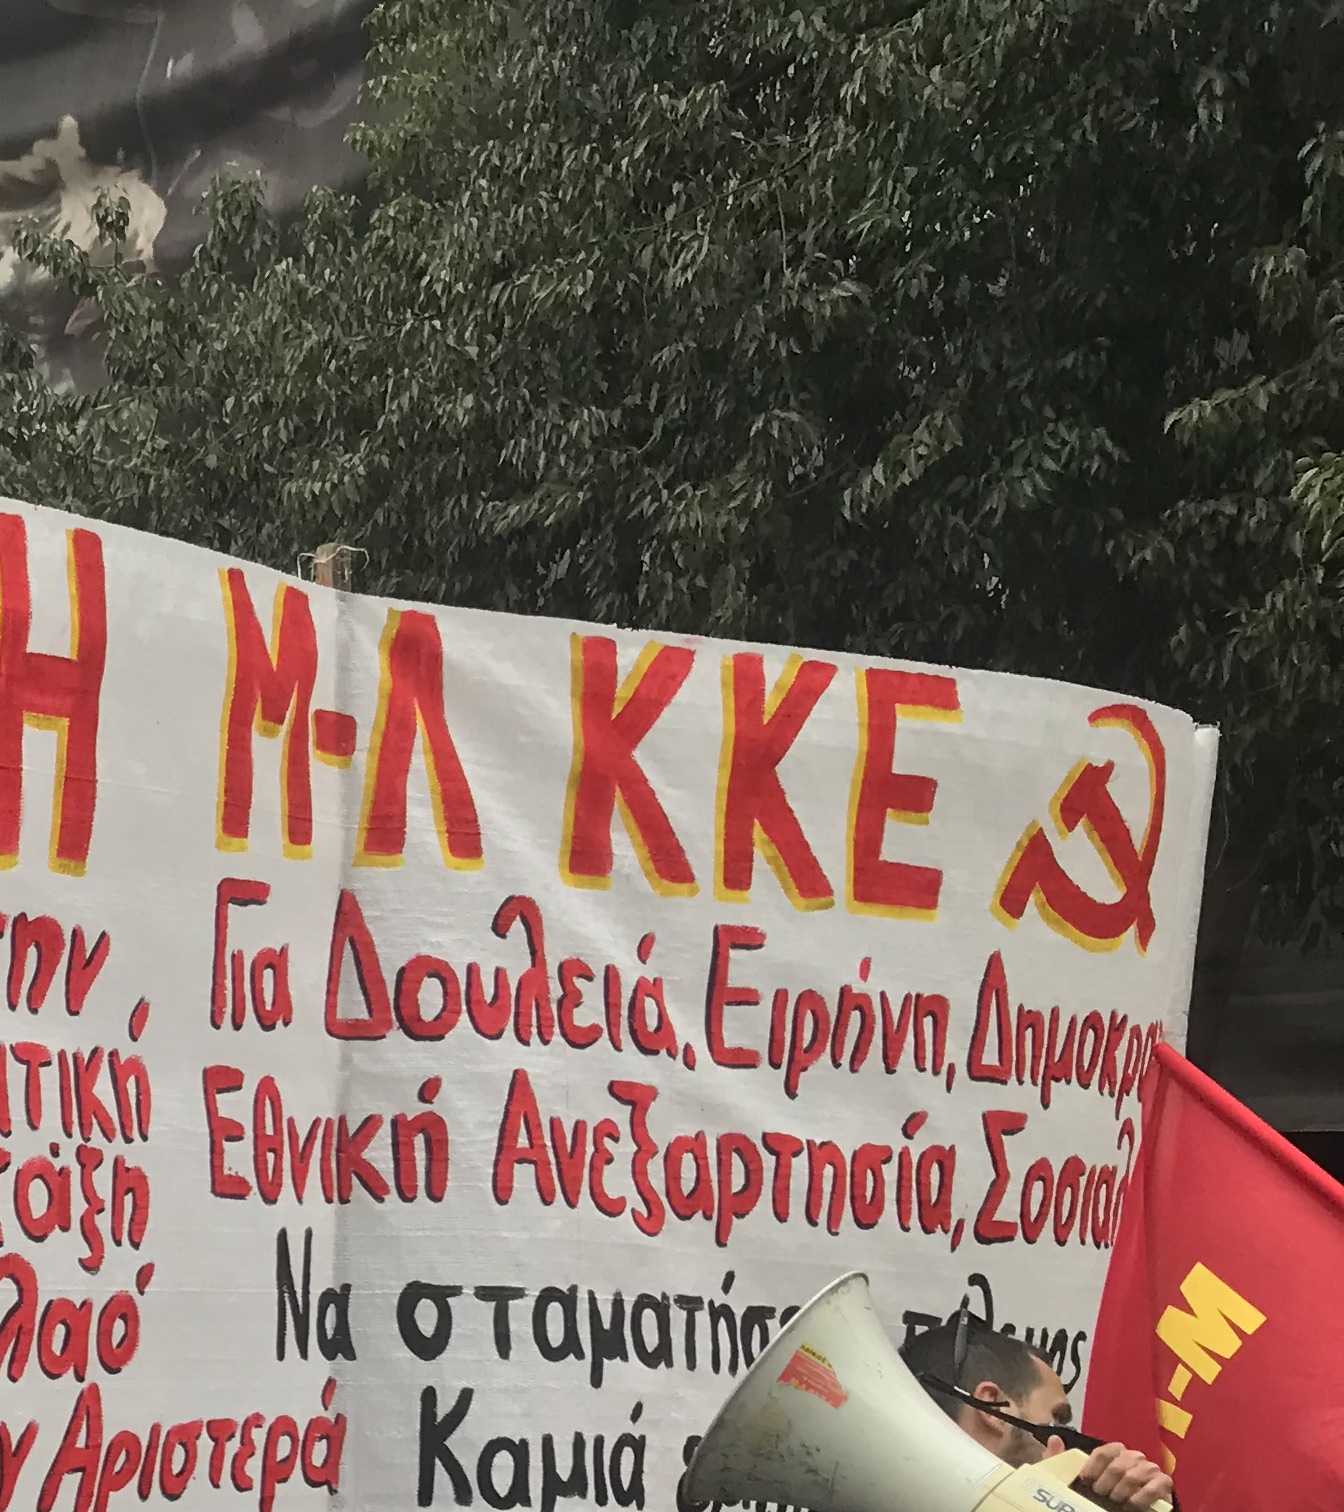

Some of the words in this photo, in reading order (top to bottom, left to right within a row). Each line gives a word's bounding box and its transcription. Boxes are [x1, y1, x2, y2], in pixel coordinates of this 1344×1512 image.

[214, 566, 485, 872] Μ-Λ
[558, 630, 964, 923] ΚΚΕ
[209, 876, 294, 1032] Για
[706, 923, 956, 1099] Ειρήνη,
[202, 1063, 450, 1205] Εθνική
[491, 1067, 965, 1252] Ανεξαρτησία,
[972, 1109, 1135, 1251] Σοσιαλ
[274, 1226, 358, 1363] Να
[396, 1270, 802, 1388] σταματήσ
